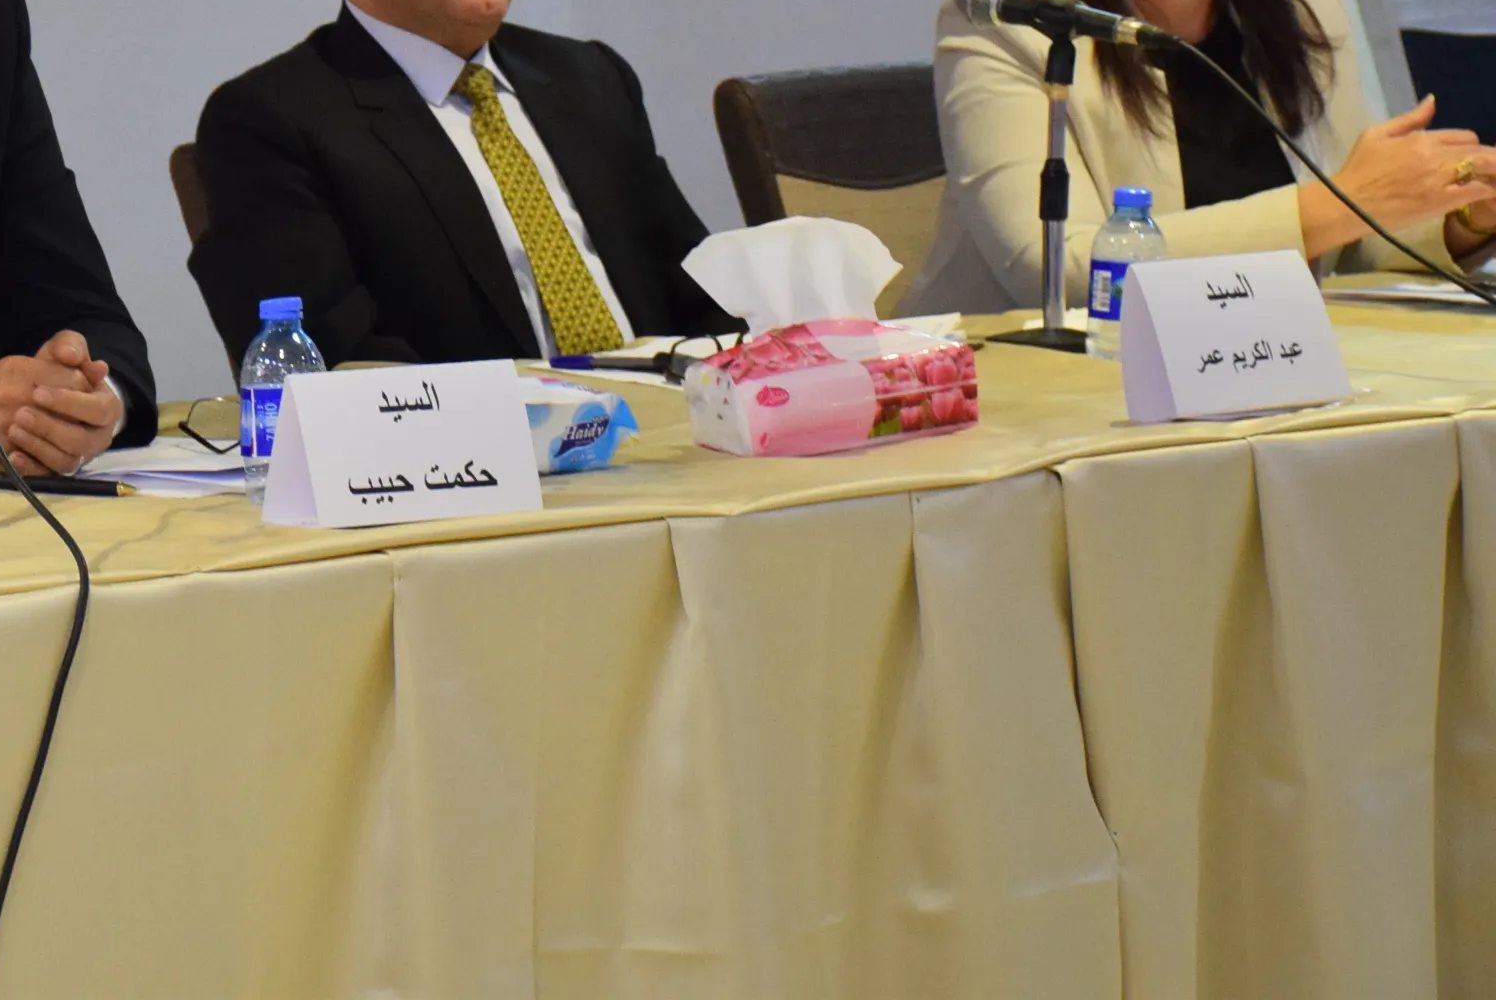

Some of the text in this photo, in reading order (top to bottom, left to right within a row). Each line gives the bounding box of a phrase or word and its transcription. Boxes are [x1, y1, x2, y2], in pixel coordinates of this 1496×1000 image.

[1207, 274, 1254, 309] السيد
[1198, 338, 1303, 373] عبد الكريم عمر
[379, 381, 439, 422] السيد
[564, 422, 604, 441] Haidy
[349, 461, 498, 504] حكمت حبيب
